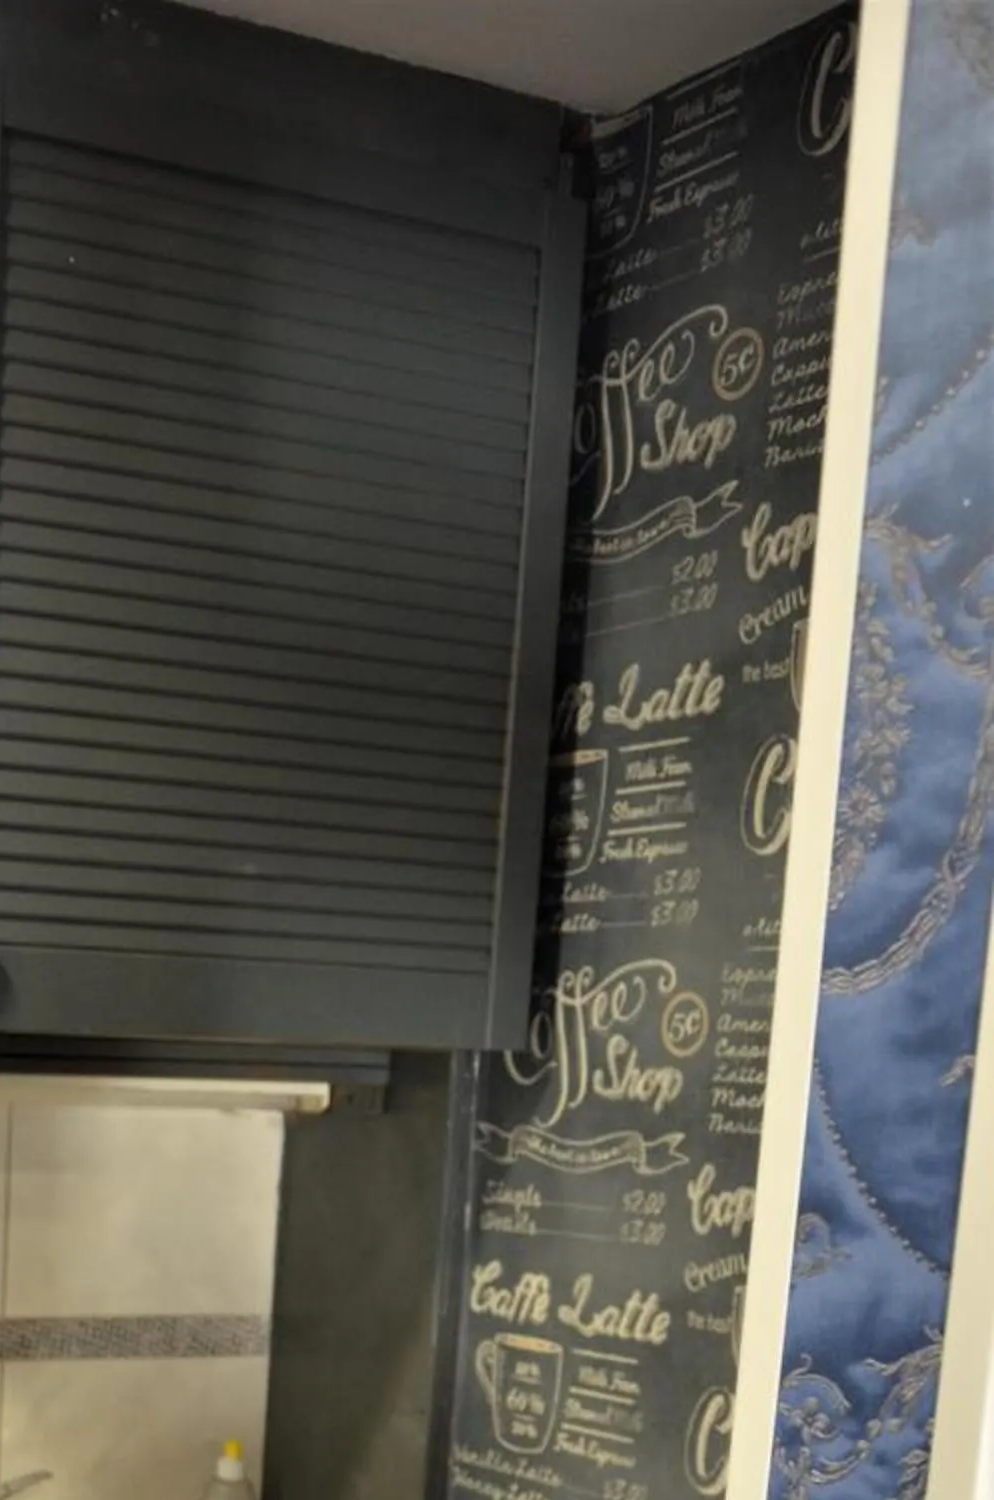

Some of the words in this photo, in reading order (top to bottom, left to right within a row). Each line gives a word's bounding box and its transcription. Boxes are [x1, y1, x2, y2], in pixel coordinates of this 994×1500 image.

[639, 399, 737, 470] Shop
[603, 657, 726, 732] Latte
[592, 1033, 684, 1114] Shop
[557, 1272, 672, 1346] Latte
